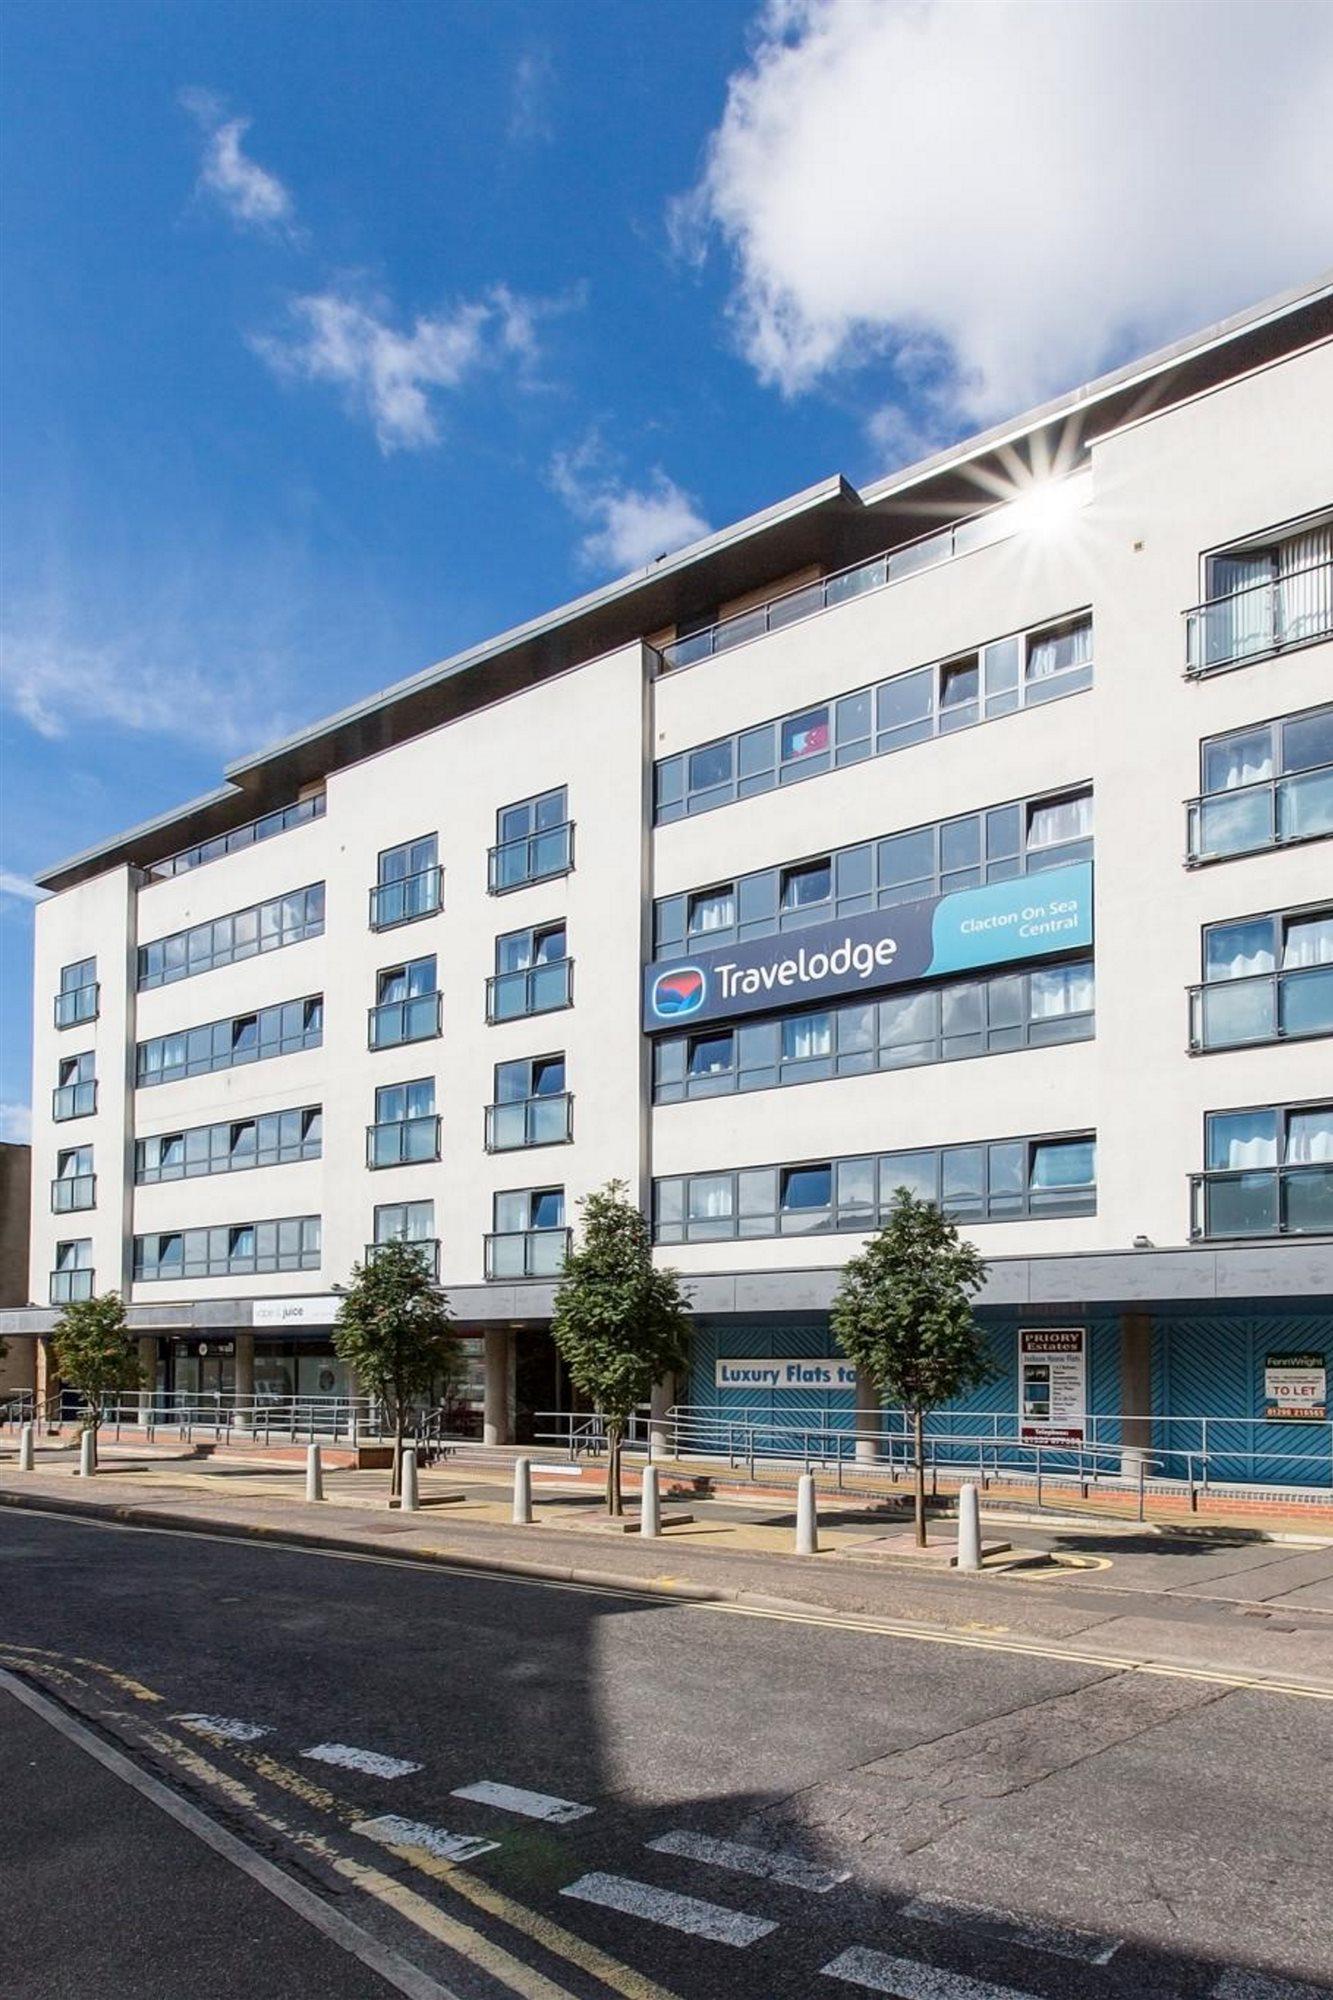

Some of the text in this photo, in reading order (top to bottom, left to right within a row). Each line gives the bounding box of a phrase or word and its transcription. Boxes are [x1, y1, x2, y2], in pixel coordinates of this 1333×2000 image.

[961, 898, 1078, 935] Clacton On Sea
[1018, 914, 1079, 940] Central
[715, 937, 898, 999] Travelodge
[282, 1305, 304, 1319] juice
[1024, 1333, 1080, 1342] PRIORY
[1026, 1342, 1078, 1351] Estates
[721, 1365, 780, 1385] Luxury
[786, 1364, 832, 1383] Flats
[1273, 1386, 1316, 1396] TO LET
